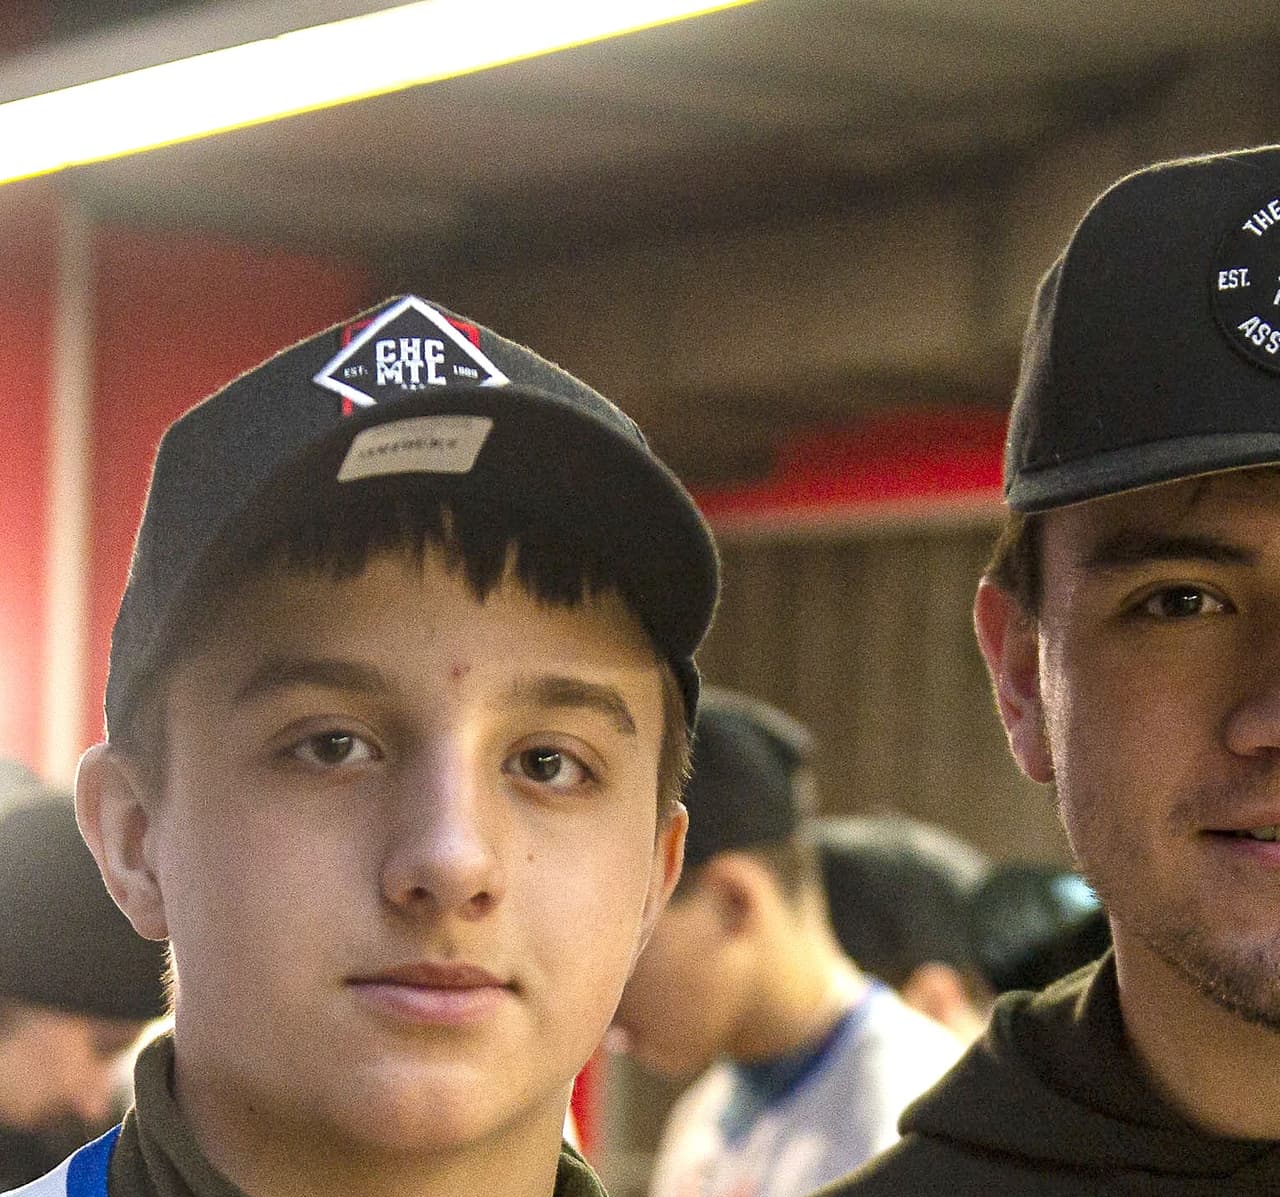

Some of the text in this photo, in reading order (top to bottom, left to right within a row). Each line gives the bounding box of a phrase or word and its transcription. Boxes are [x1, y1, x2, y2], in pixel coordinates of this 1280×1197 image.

[1218, 268, 1251, 290] EST.
[375, 337, 445, 363] CHC
[376, 360, 448, 386] MTL
